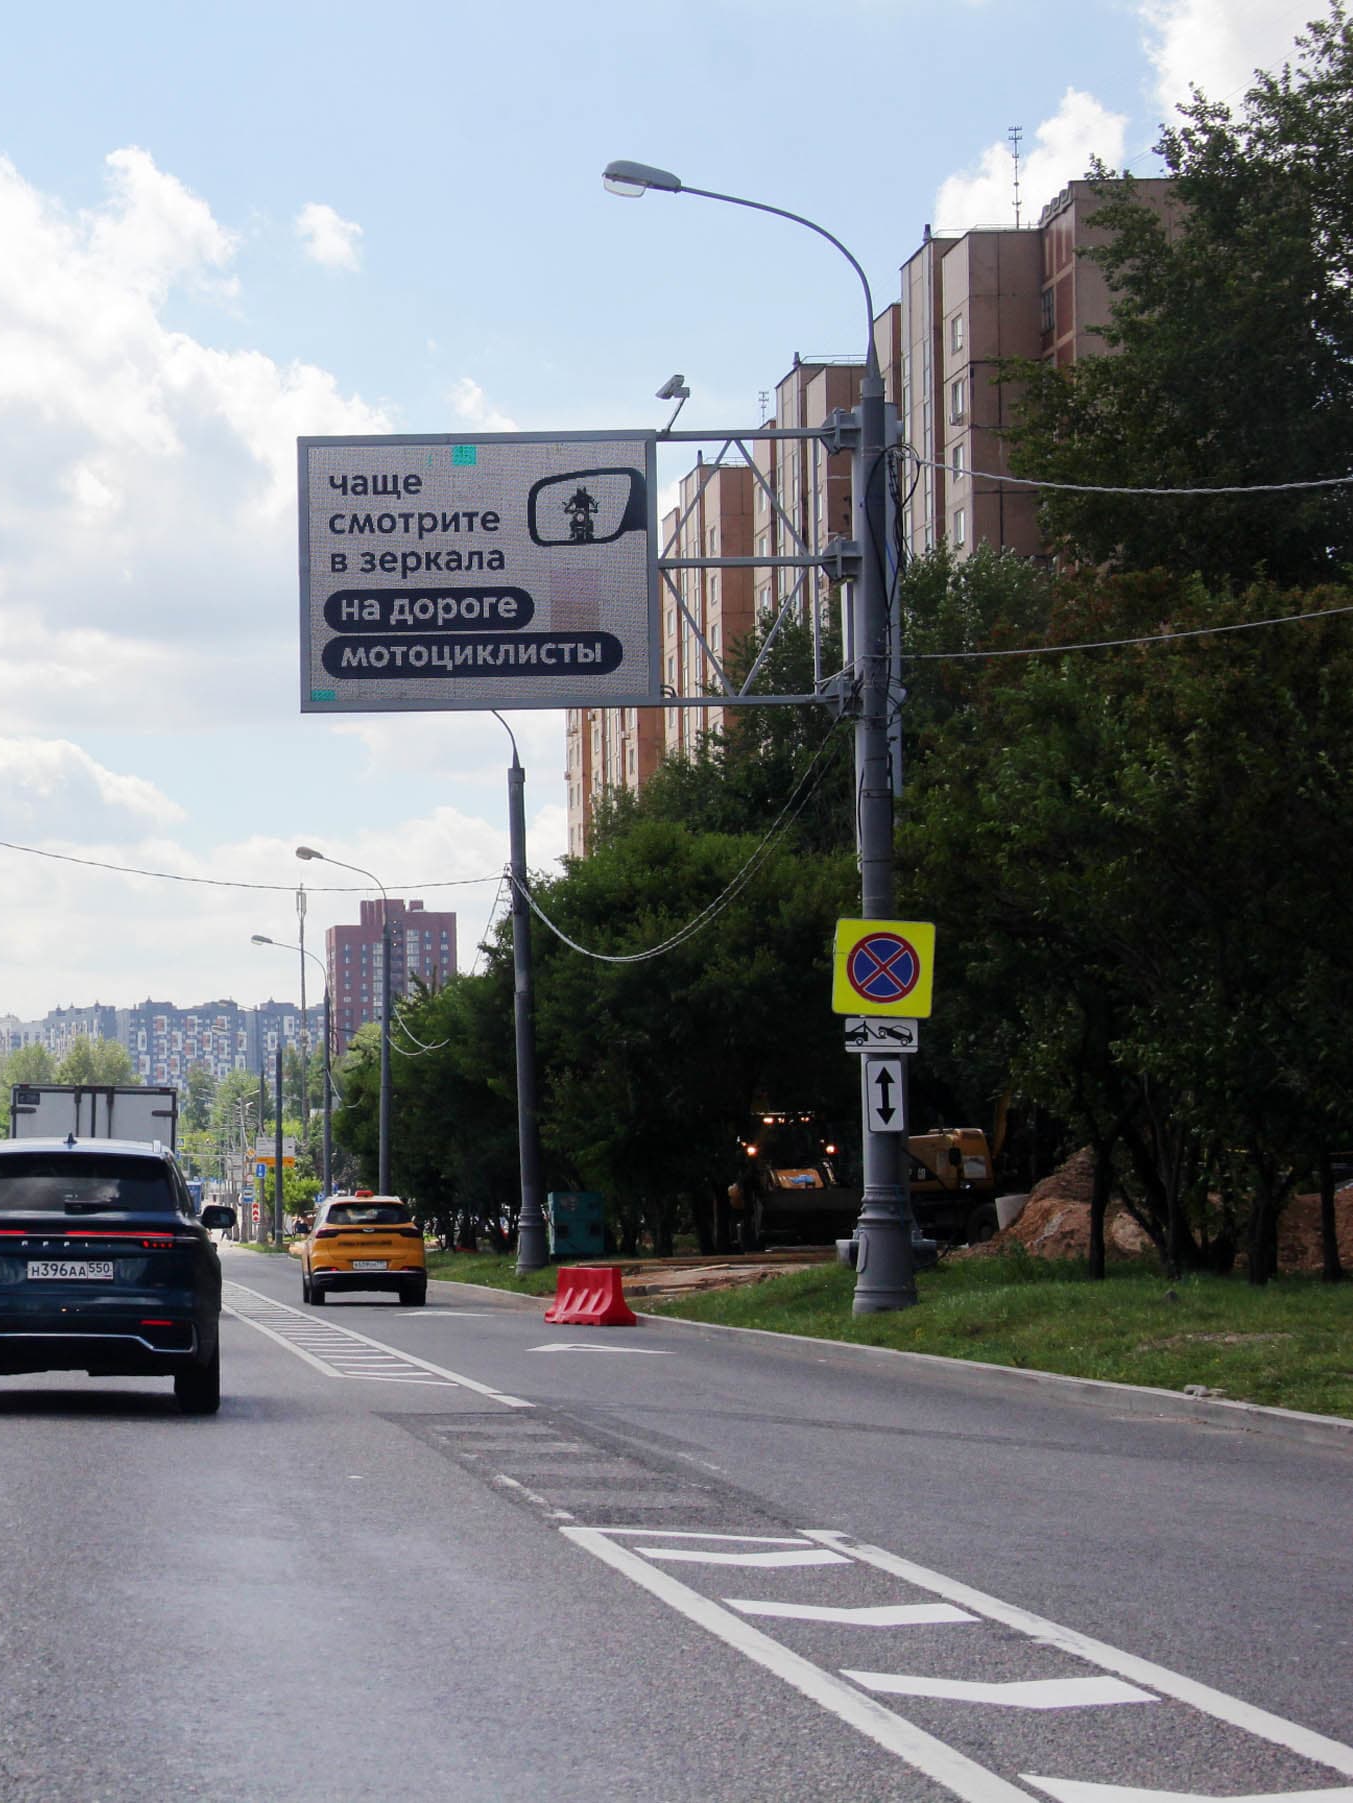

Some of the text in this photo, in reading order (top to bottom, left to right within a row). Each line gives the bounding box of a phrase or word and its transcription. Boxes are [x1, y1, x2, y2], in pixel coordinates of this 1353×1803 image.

[329, 473, 423, 500] чаще
[328, 510, 500, 539] смотрите
[331, 549, 506, 579] в зеркала
[340, 596, 518, 626] на дороге
[341, 643, 603, 671] мотоциклисты
